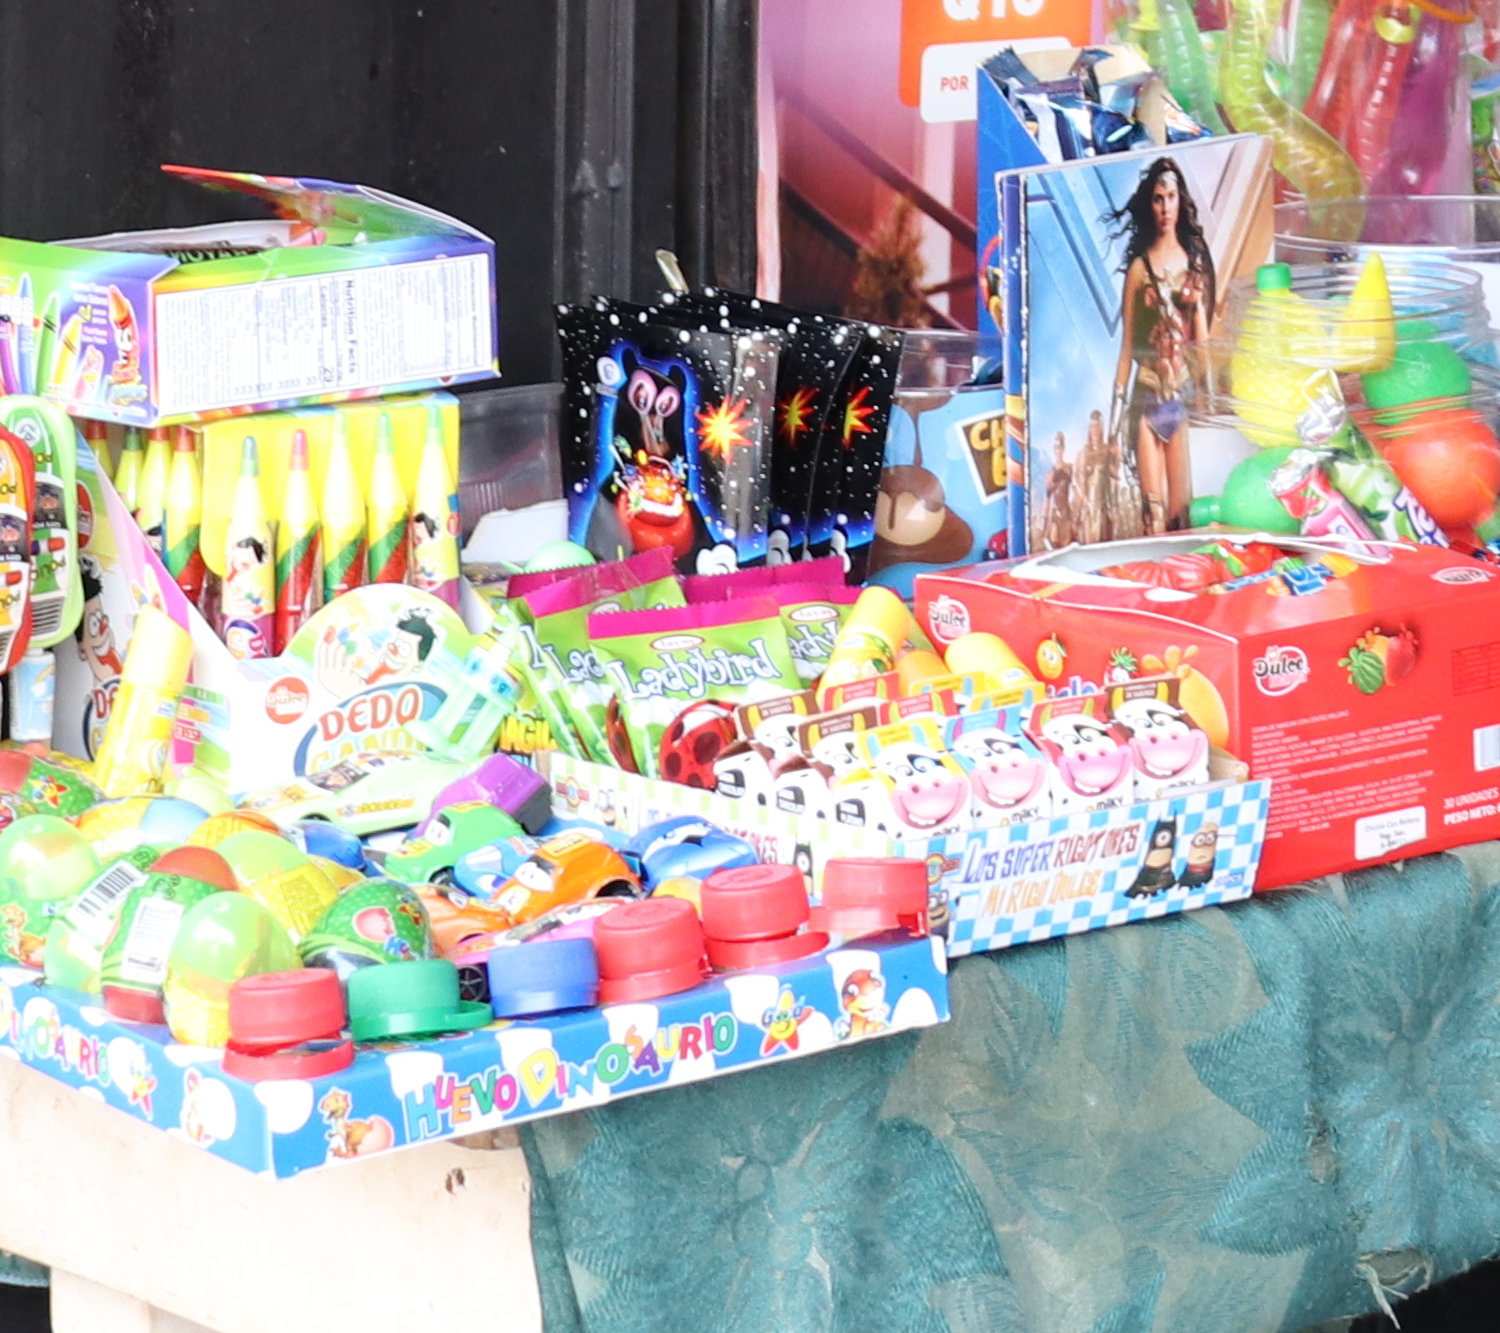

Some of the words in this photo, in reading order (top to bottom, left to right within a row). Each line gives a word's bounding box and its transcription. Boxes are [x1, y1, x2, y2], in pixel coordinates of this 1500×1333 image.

[939, 75, 970, 93] POR
[606, 637, 781, 700] Ladybird
[319, 687, 422, 743] DEDO
[1444, 810, 1469, 825] PESO
[1001, 841, 1053, 880] SUPER
[403, 1066, 518, 1140] HUEVO
[517, 1012, 736, 1105] DINOSAURIO
